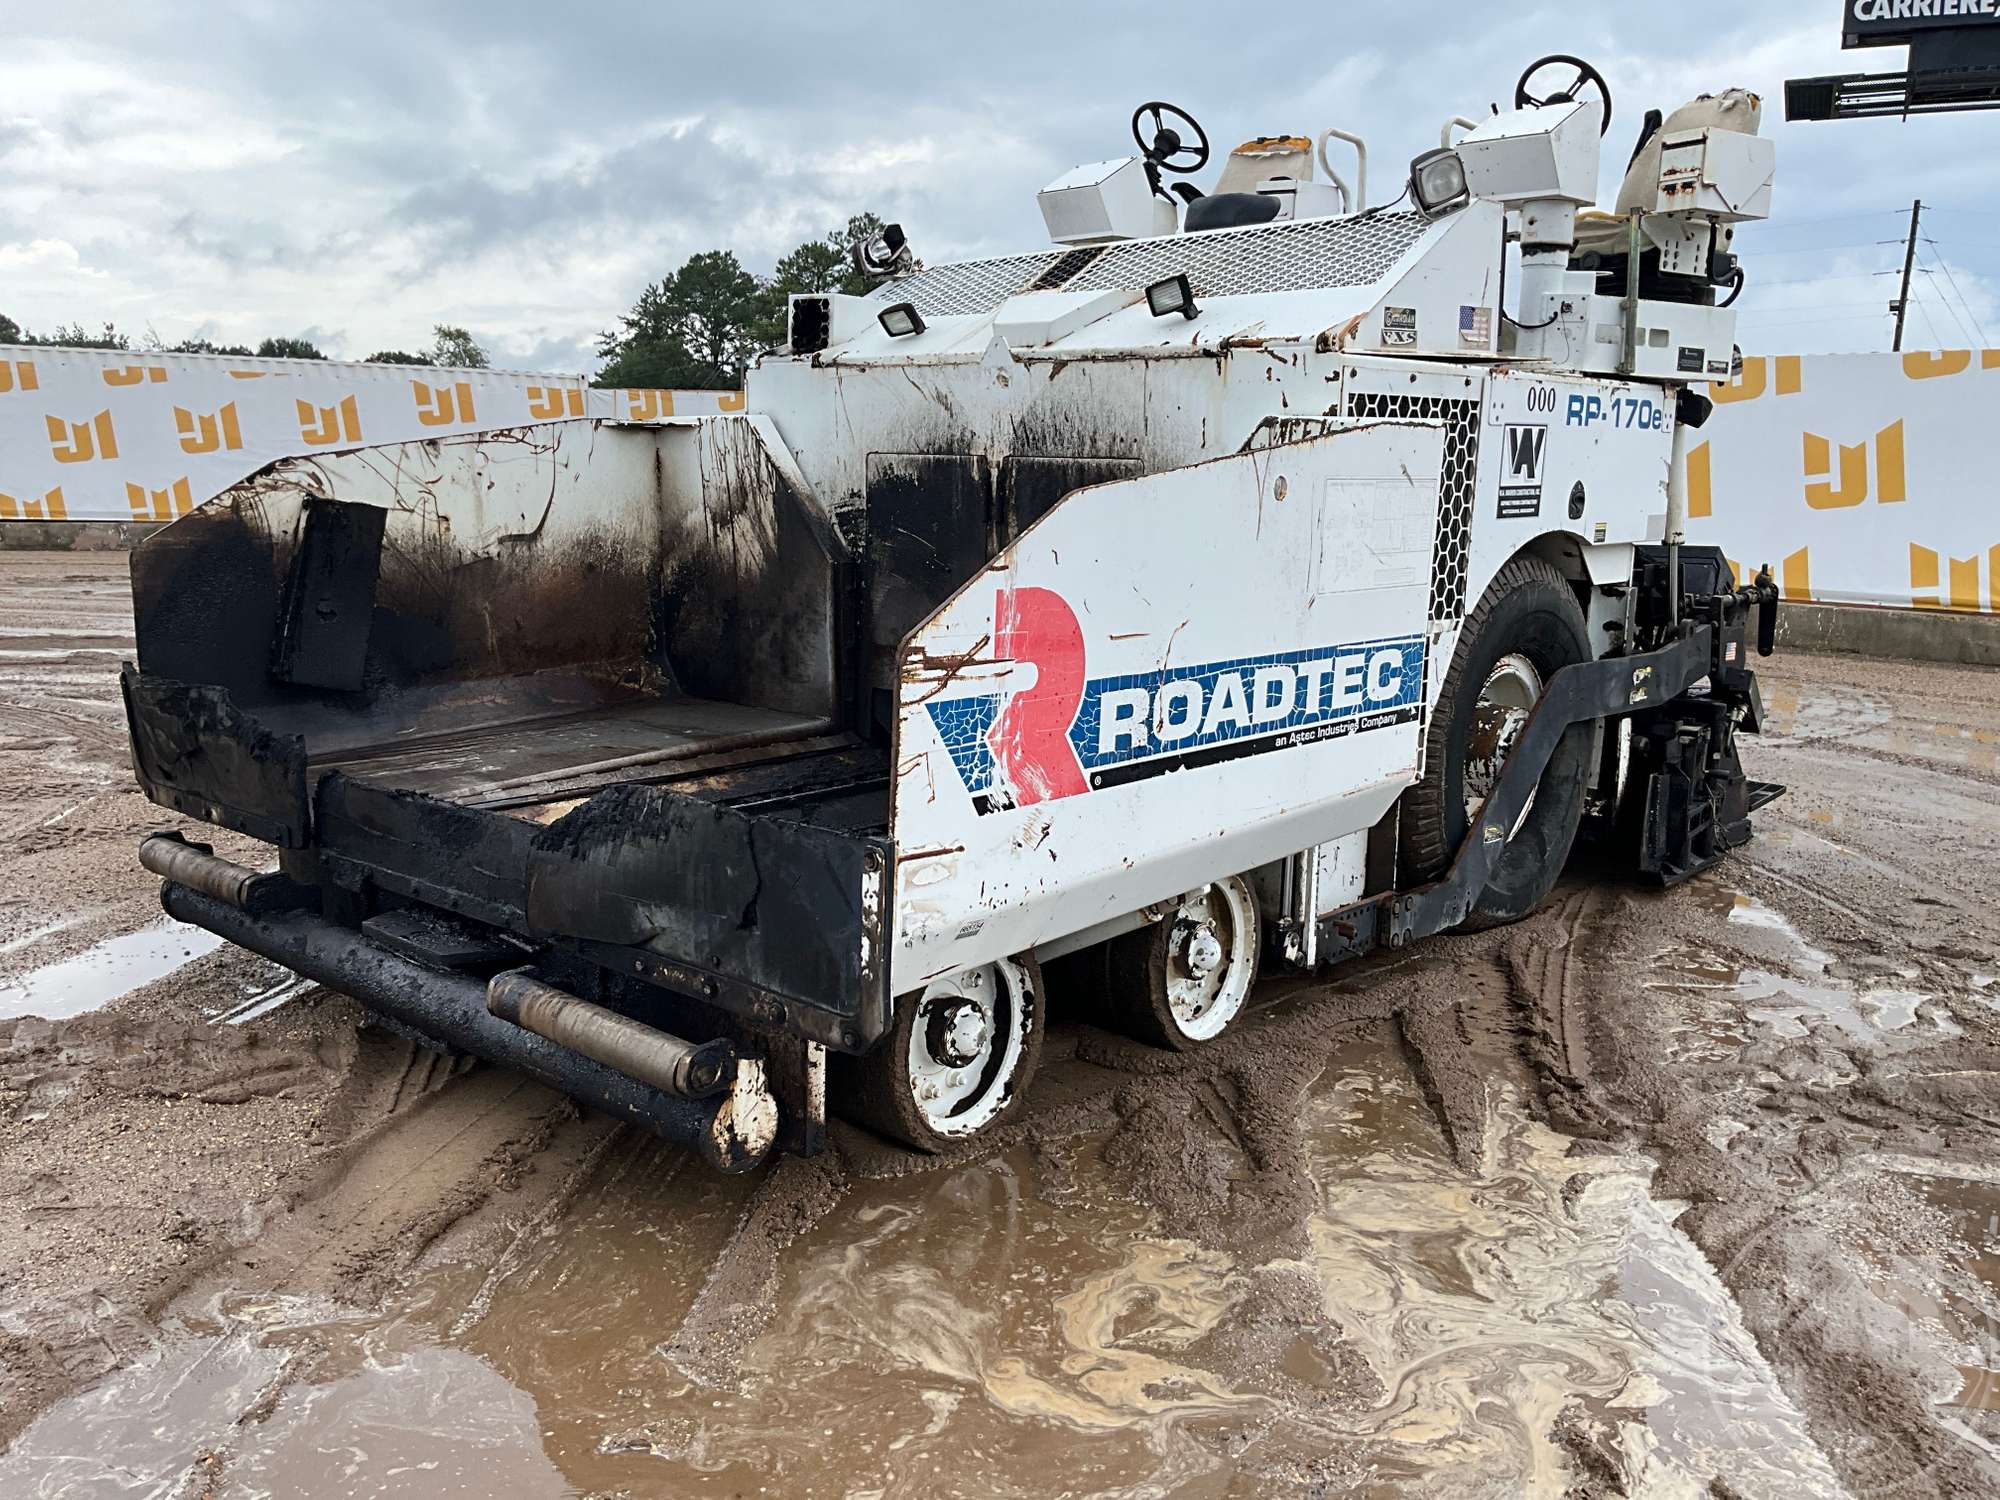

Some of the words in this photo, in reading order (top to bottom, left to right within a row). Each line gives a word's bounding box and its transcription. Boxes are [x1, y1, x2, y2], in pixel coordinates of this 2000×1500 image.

[1527, 386, 1556, 412] 000
[1566, 393, 1662, 430] RP-170e
[1098, 646, 1404, 754] ROADTEC
[1275, 736, 1287, 747] an
[1289, 731, 1316, 745] Astec
[1317, 721, 1360, 738] Industries
[1361, 714, 1398, 729] Company
